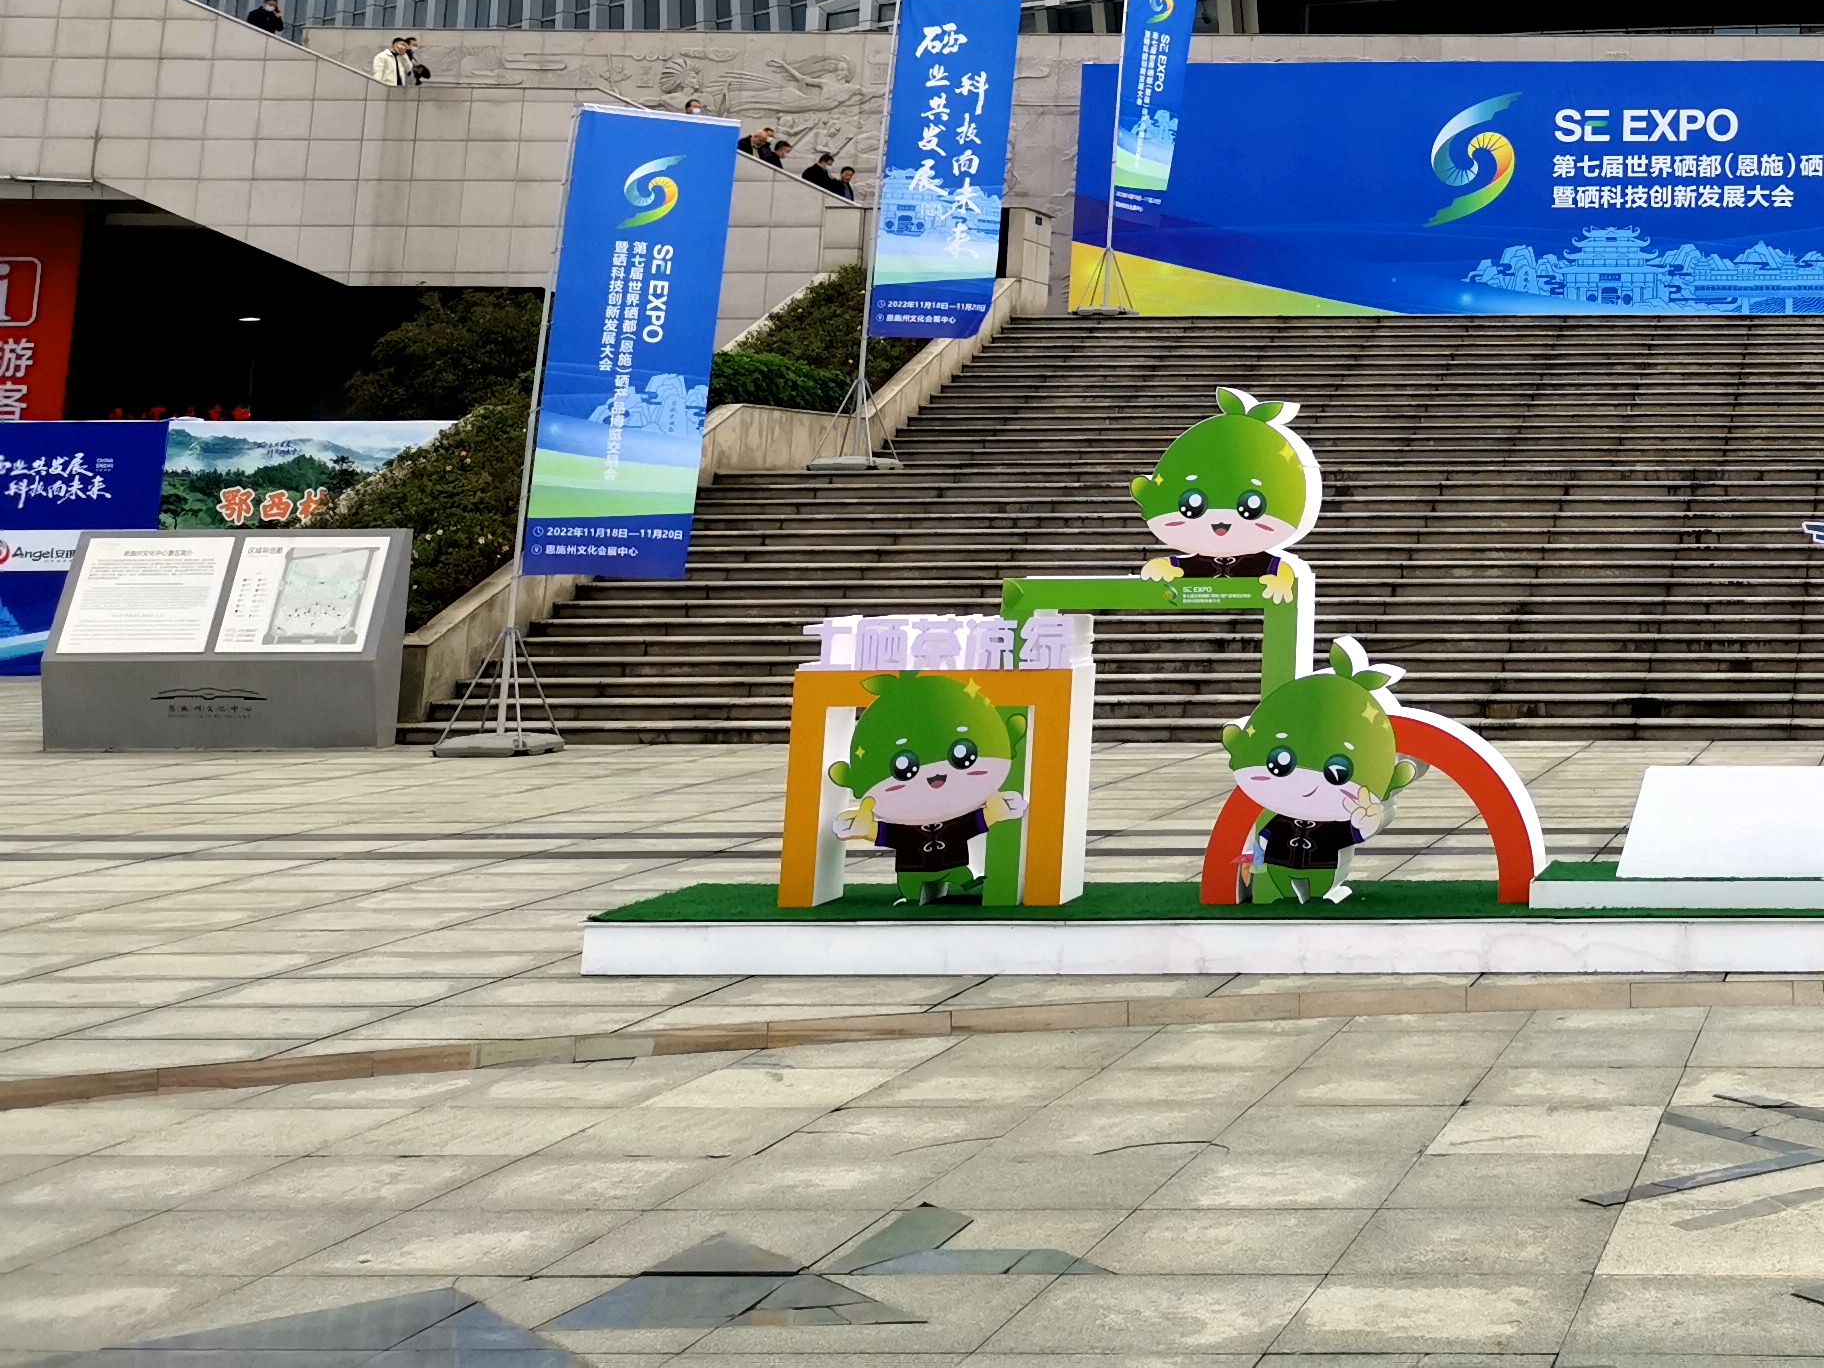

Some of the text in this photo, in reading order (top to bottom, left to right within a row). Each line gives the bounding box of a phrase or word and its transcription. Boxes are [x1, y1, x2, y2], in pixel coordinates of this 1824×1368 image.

[1154, 54, 1168, 92] EXPO
[908, 22, 969, 197] 硒业共发展
[1554, 108, 1739, 143] SE EXPO
[940, 70, 990, 259] 科技向未来
[1551, 184, 1795, 209] 暨硒科技创新发展大会
[598, 240, 630, 372] 暨硒科技创新发展大会
[642, 279, 669, 344] EXPO
[4, 475, 112, 509] 科技向未来
[545, 544, 639, 557] 恩施州文化会展中心
[797, 616, 1074, 671] 土硒茶凉绿
